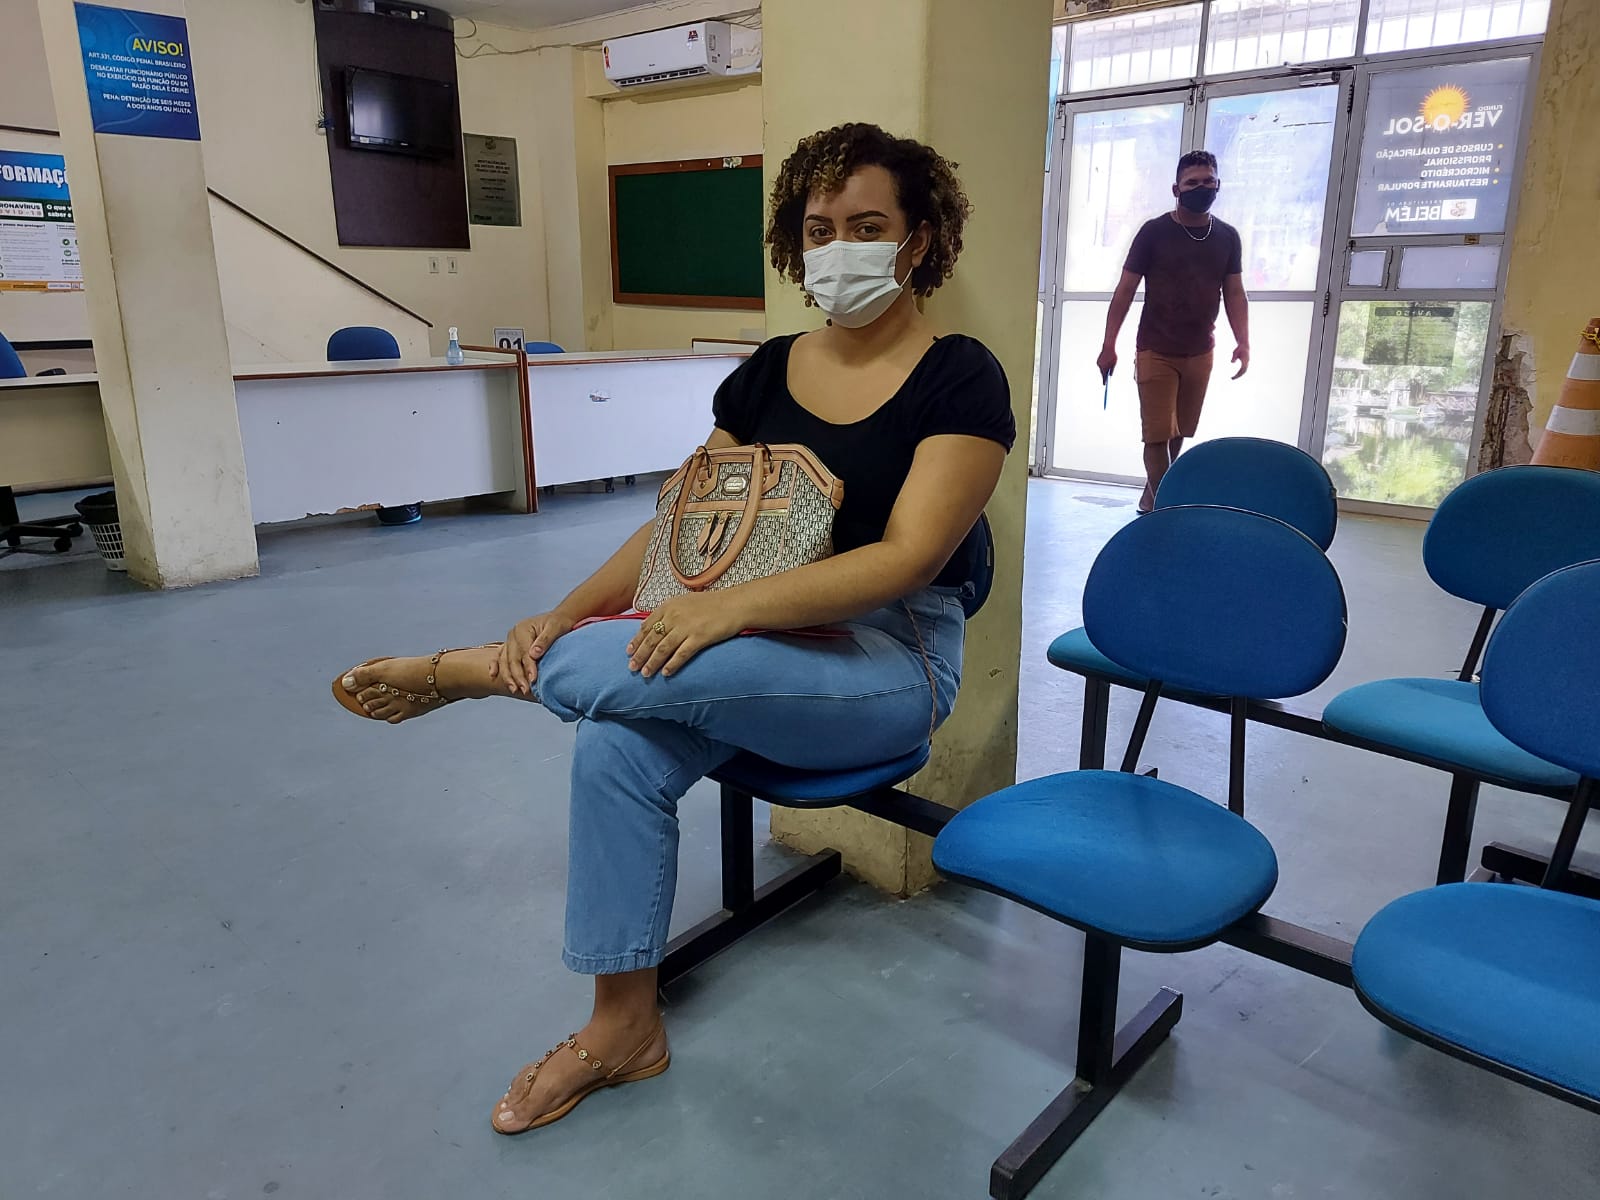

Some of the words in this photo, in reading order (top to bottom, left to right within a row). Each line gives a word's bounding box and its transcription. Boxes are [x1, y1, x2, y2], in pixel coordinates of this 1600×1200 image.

[133, 38, 184, 56] AVISO!
[112, 54, 135, 62] CÓDIGO
[136, 57, 154, 65] PENAL
[155, 60, 186, 69] BRASILEIRO
[90, 63, 124, 73] DESACATAR
[124, 68, 163, 77] FUNCIONÁRIO
[164, 72, 188, 80] PÚBLICO
[107, 73, 137, 81] EXERCÍCIO
[147, 76, 170, 85] FUNÇÃO
[131, 82, 151, 90] RAZÃO
[121, 95, 151, 103] DETENÇÃO
[0, 164, 67, 188] ORMAÇ
[499, 337, 522, 350] 01
